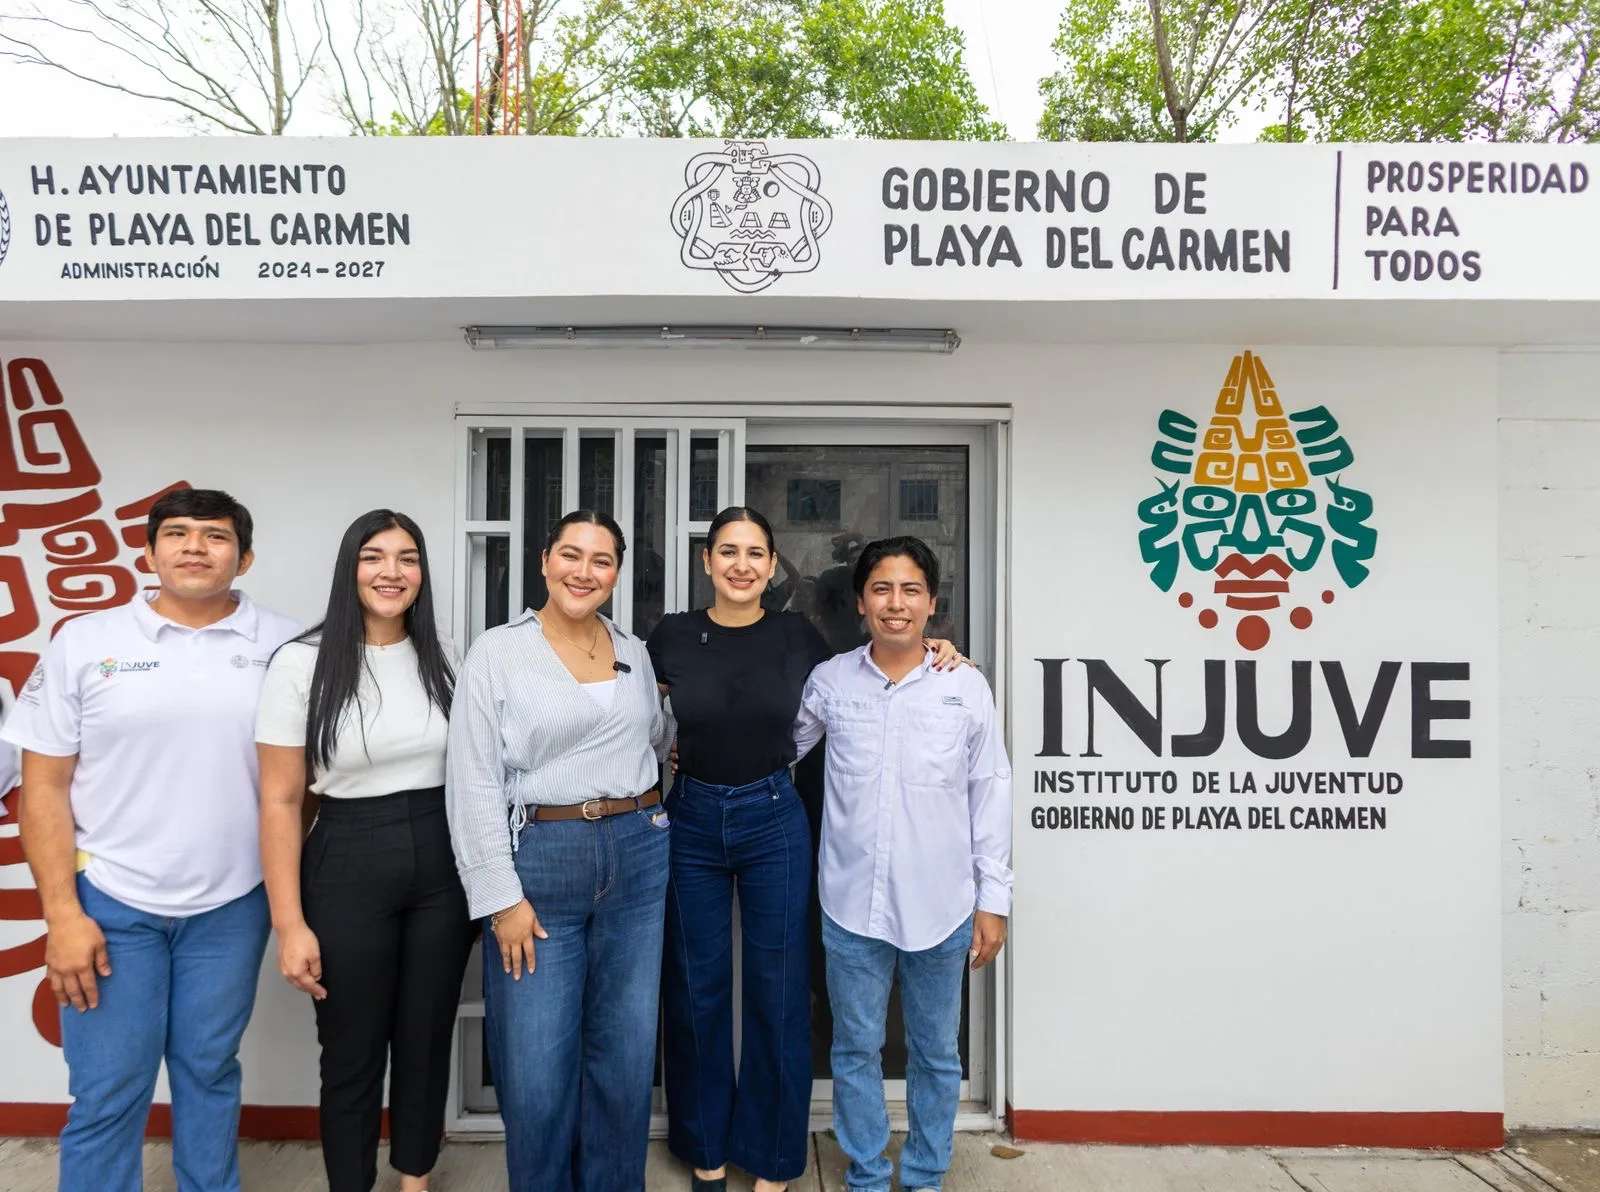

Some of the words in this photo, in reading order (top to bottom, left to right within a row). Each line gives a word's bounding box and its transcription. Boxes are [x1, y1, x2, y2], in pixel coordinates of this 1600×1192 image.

[31, 165, 69, 195] H.
[79, 164, 345, 195] AYUNTAMIENTO
[882, 167, 1109, 213] GOBIERNO
[1155, 172, 1206, 214] DE
[1368, 161, 1588, 193] PROSPERIDAD
[35, 213, 72, 246] DE
[89, 213, 194, 246] PLAYA
[206, 212, 261, 245] DEL
[271, 212, 410, 245] CARMEN
[1367, 206, 1459, 237] PARA
[884, 224, 1022, 267] PLAYA
[1047, 227, 1113, 269] DEL
[1122, 226, 1290, 273] CARMEN
[61, 255, 219, 279] ADMINISTRACIÓN
[1365, 250, 1481, 281] TODOS
[120, 661, 160, 669] INJUVE
[1034, 659, 1471, 759] INJUVE
[1034, 771, 1177, 794] INSTITUTO
[1193, 772, 1220, 793] DE
[1230, 772, 1257, 793] LA
[1266, 772, 1403, 794] JUVENTUD
[1031, 806, 1134, 830] GOBIERNO
[1142, 807, 1165, 830] DE
[1173, 807, 1242, 829] PLAYA
[1248, 807, 1285, 829] DEL
[1290, 806, 1386, 829] CARMEN
